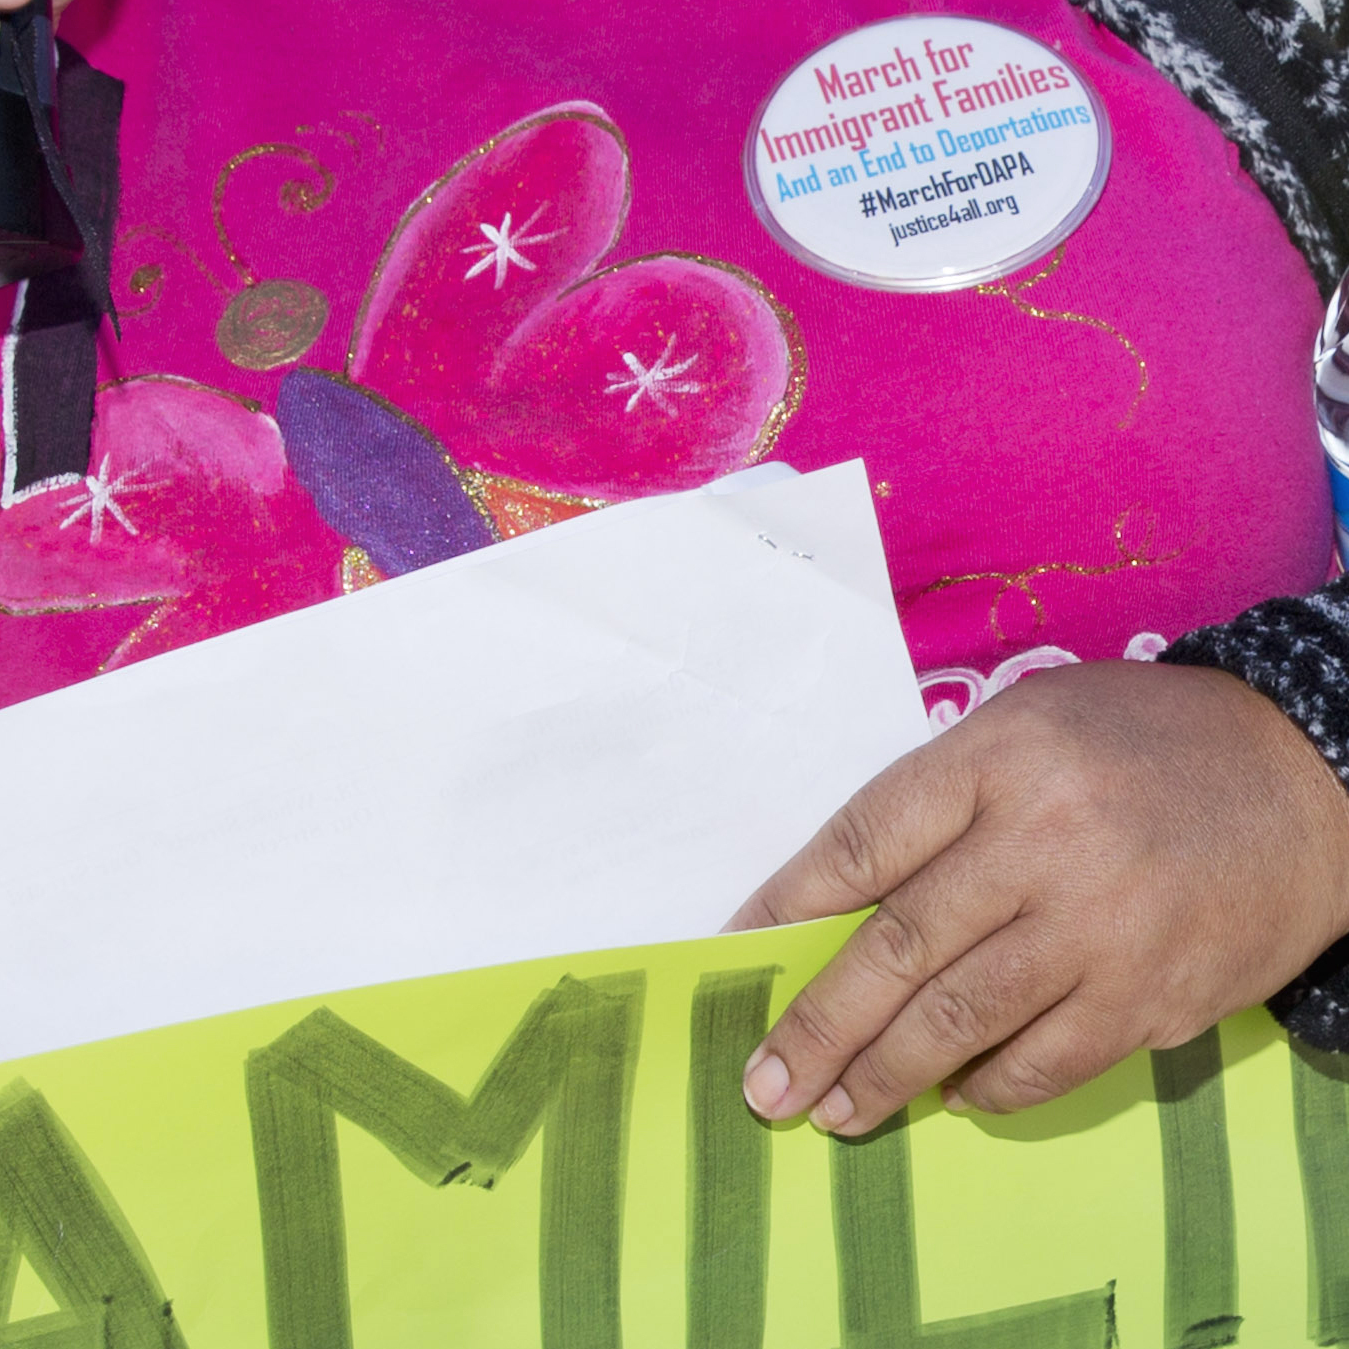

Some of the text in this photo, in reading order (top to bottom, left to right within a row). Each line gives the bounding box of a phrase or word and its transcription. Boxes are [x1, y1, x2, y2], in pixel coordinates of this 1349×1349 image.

[813, 39, 974, 104] March for
[760, 62, 1070, 163] Immigrant Families
[775, 105, 1091, 202] And an End to Deportations
[859, 151, 1035, 218] #MarchForDAPA
[888, 194, 1020, 246] justice4all.org
